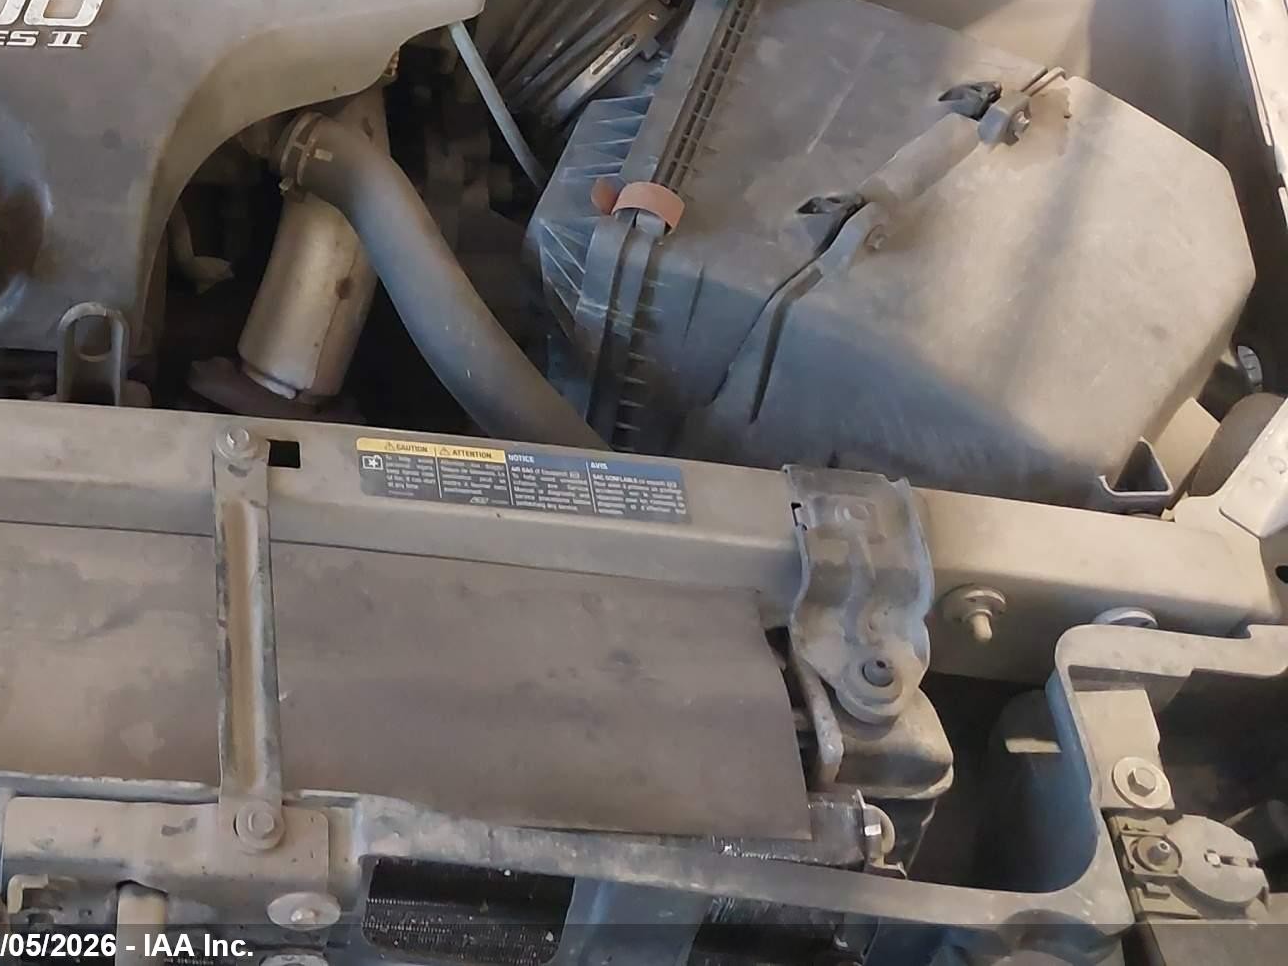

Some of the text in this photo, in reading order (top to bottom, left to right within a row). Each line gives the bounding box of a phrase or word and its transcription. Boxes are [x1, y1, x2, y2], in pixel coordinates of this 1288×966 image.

[47, 31, 87, 48] II
[396, 443, 428, 453] CAUTION
[452, 449, 492, 459] ATTENTION
[508, 454, 535, 464] NOTICE
[590, 462, 609, 470] AVIS
